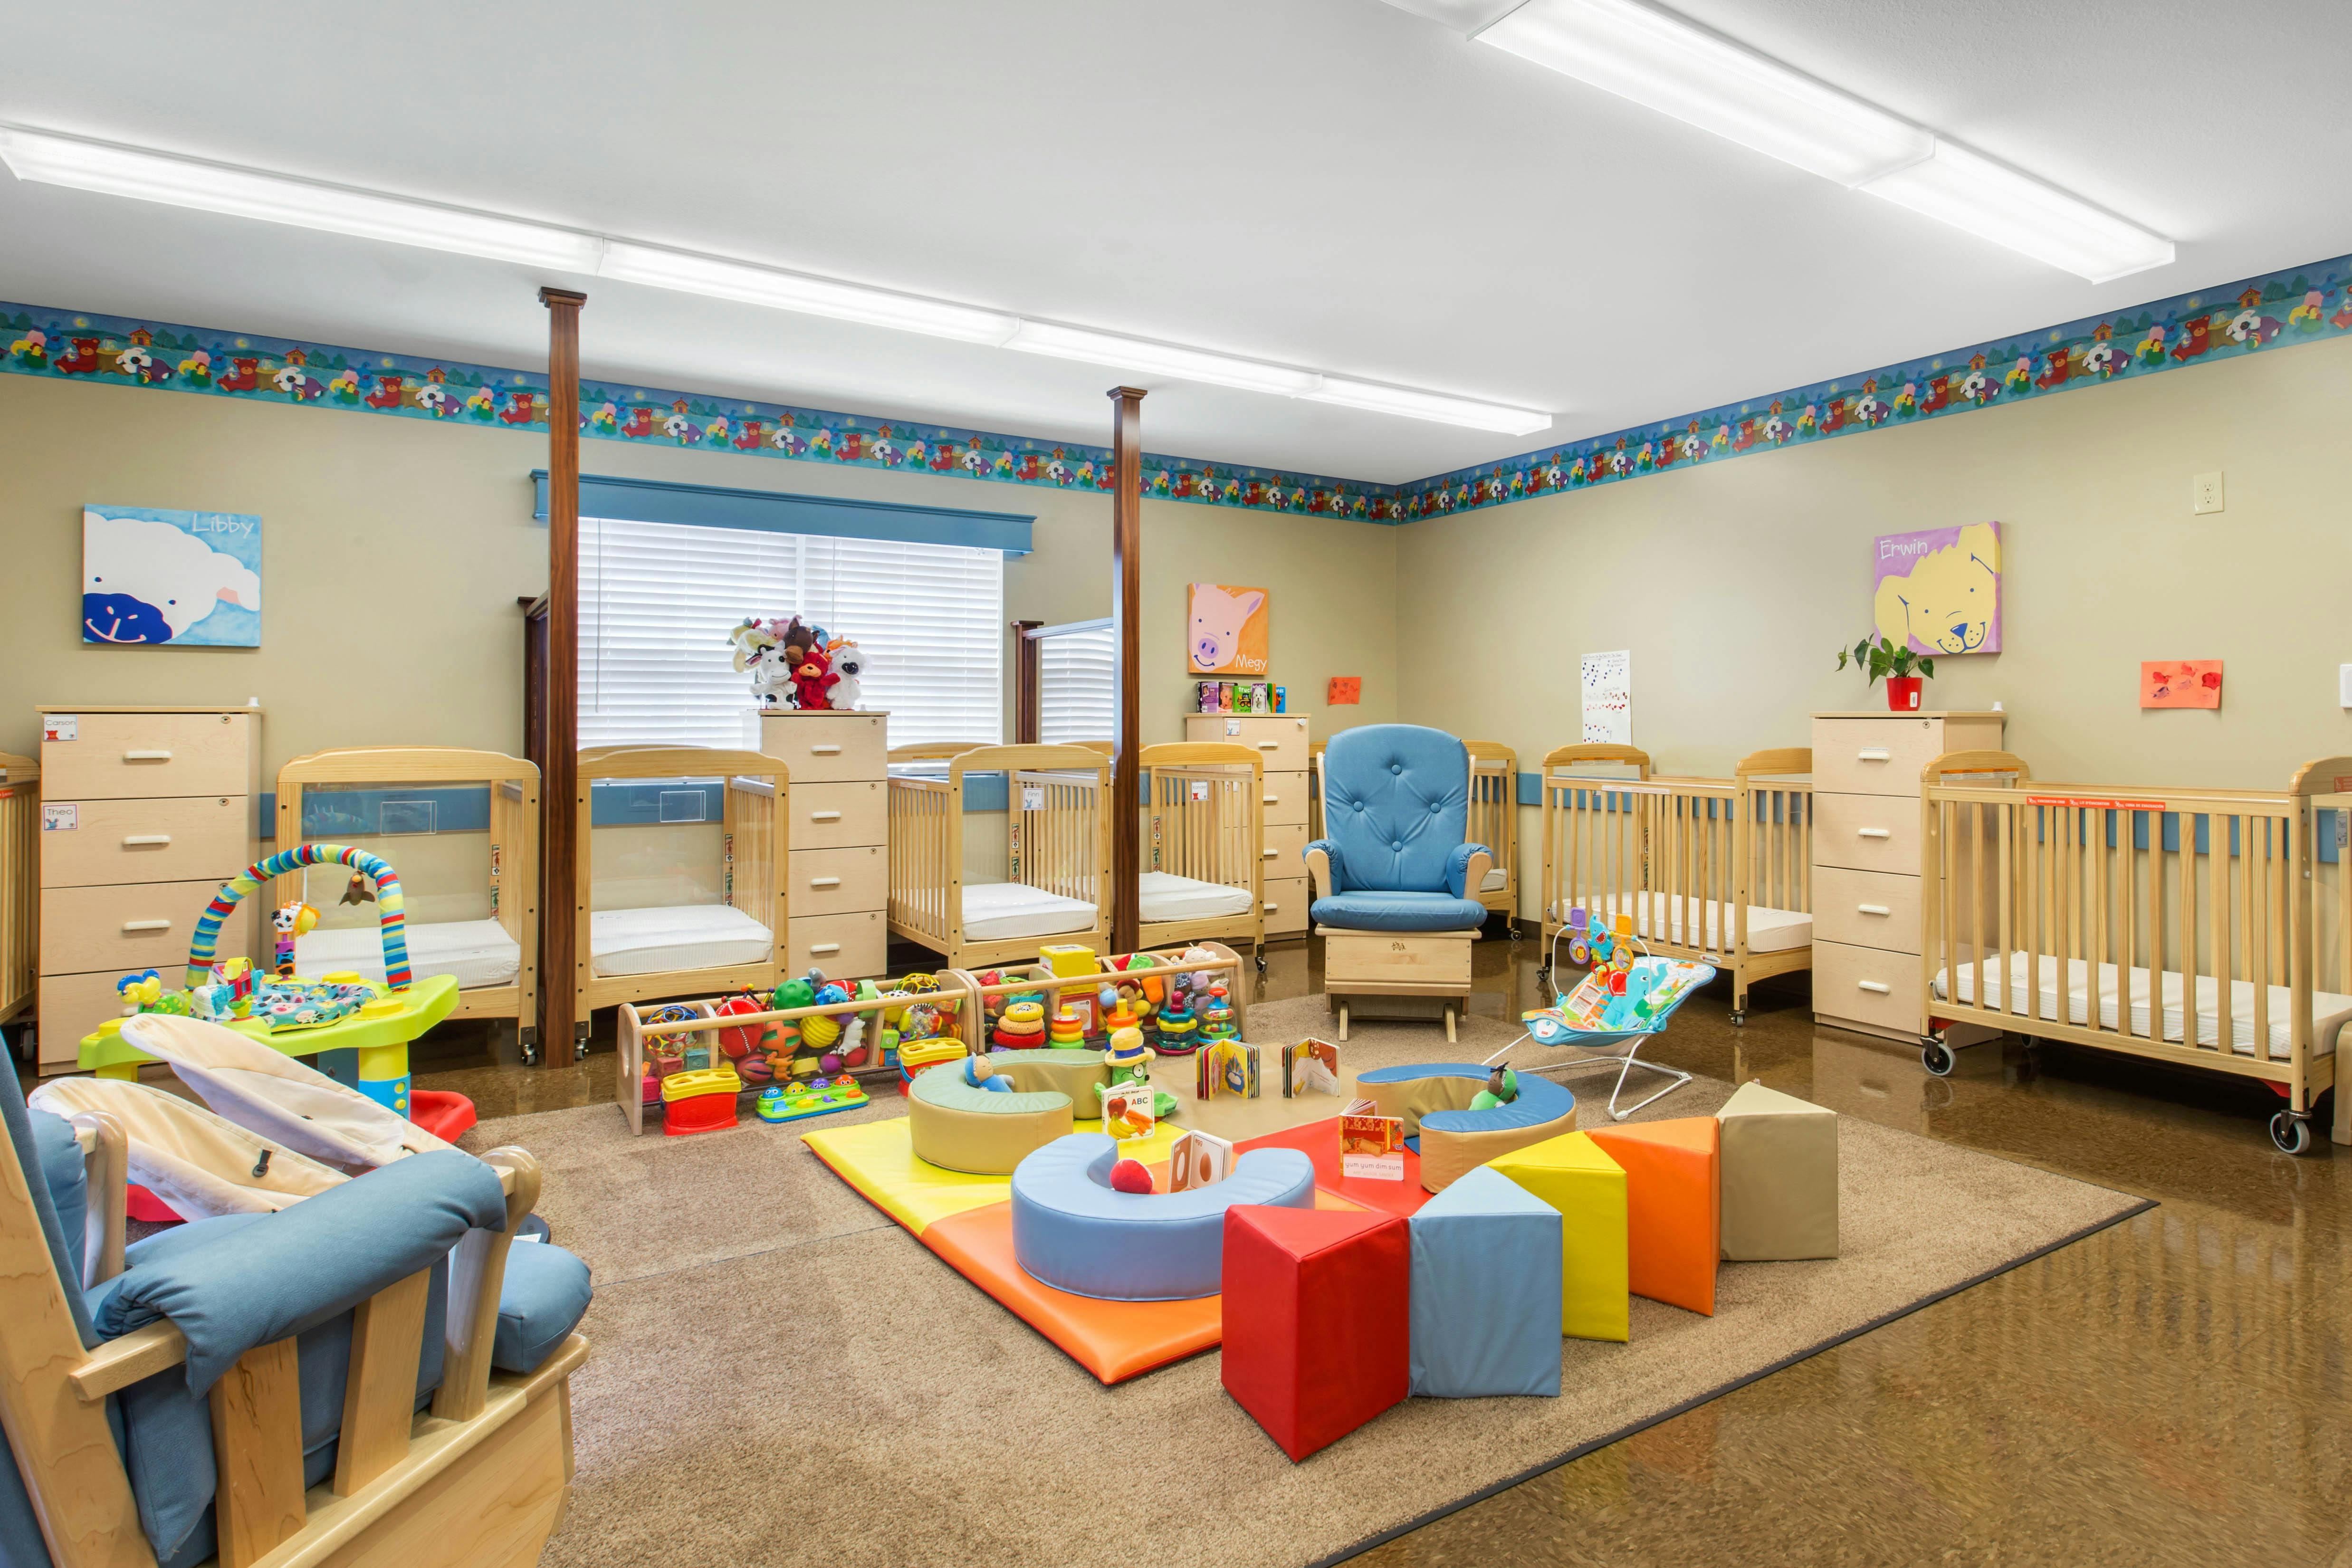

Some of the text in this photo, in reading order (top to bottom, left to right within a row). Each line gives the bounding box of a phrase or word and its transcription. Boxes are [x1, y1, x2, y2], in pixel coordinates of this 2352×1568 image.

[192, 513, 255, 539] Libby
[1880, 539, 1928, 559] Erwin
[1235, 654, 1267, 672] Megy
[1132, 1097, 1148, 1106] ABC
[1195, 1138, 1203, 1147] egg
